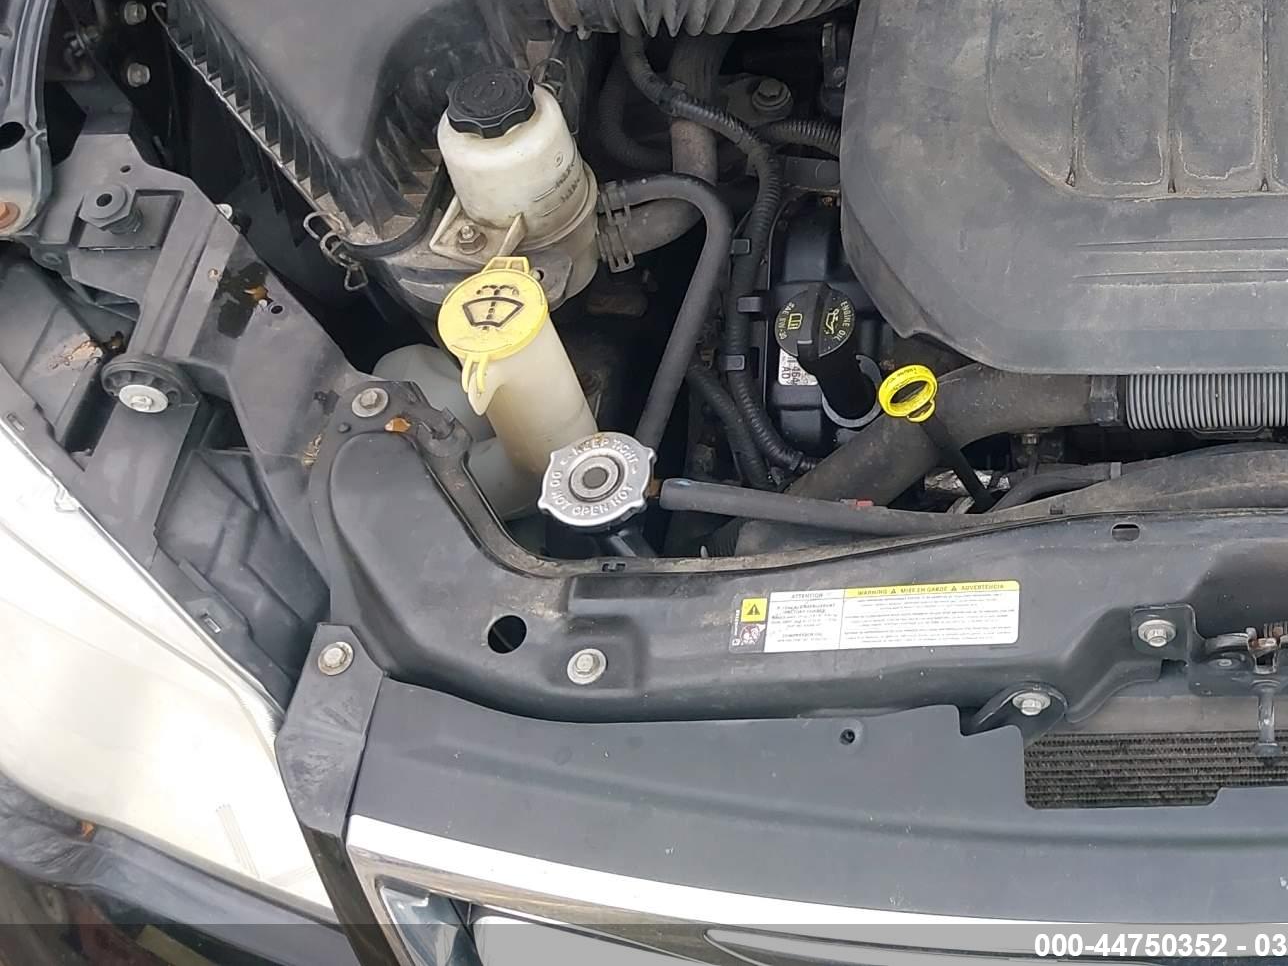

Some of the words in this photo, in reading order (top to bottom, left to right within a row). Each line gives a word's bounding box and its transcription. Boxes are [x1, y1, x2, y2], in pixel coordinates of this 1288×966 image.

[833, 329, 847, 342] OIL
[572, 437, 610, 456] KEEP
[551, 490, 573, 510] NOT
[572, 504, 610, 516] OPEN
[610, 485, 633, 507] HOT
